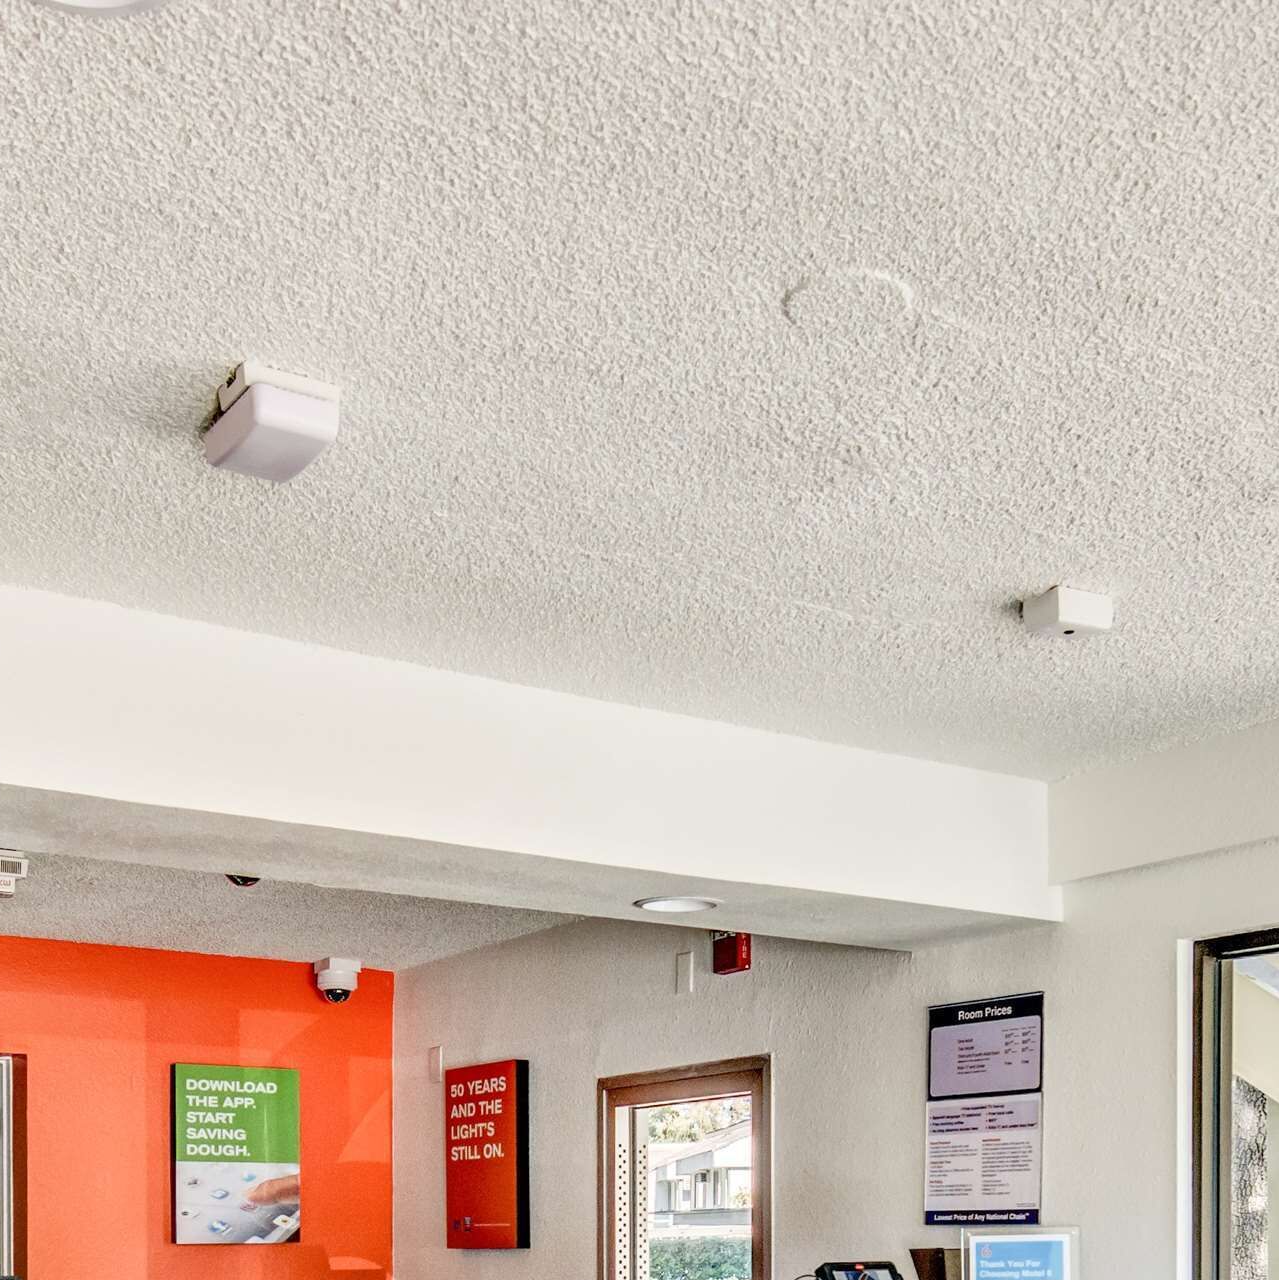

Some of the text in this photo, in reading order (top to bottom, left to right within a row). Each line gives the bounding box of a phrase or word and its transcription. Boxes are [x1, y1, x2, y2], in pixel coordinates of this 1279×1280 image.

[958, 1006, 1012, 1021] Room Prices
[186, 1079, 277, 1094] DOWNLOAD
[450, 1076, 507, 1098] 50 YEARS
[186, 1095, 256, 1109] THE APP.
[451, 1099, 502, 1119] AND THE
[186, 1111, 236, 1124] START
[186, 1127, 247, 1141] SAVING
[451, 1121, 495, 1140] LIGHT'S
[186, 1144, 250, 1157] DOUGH.
[451, 1143, 504, 1161] STILL ON.
